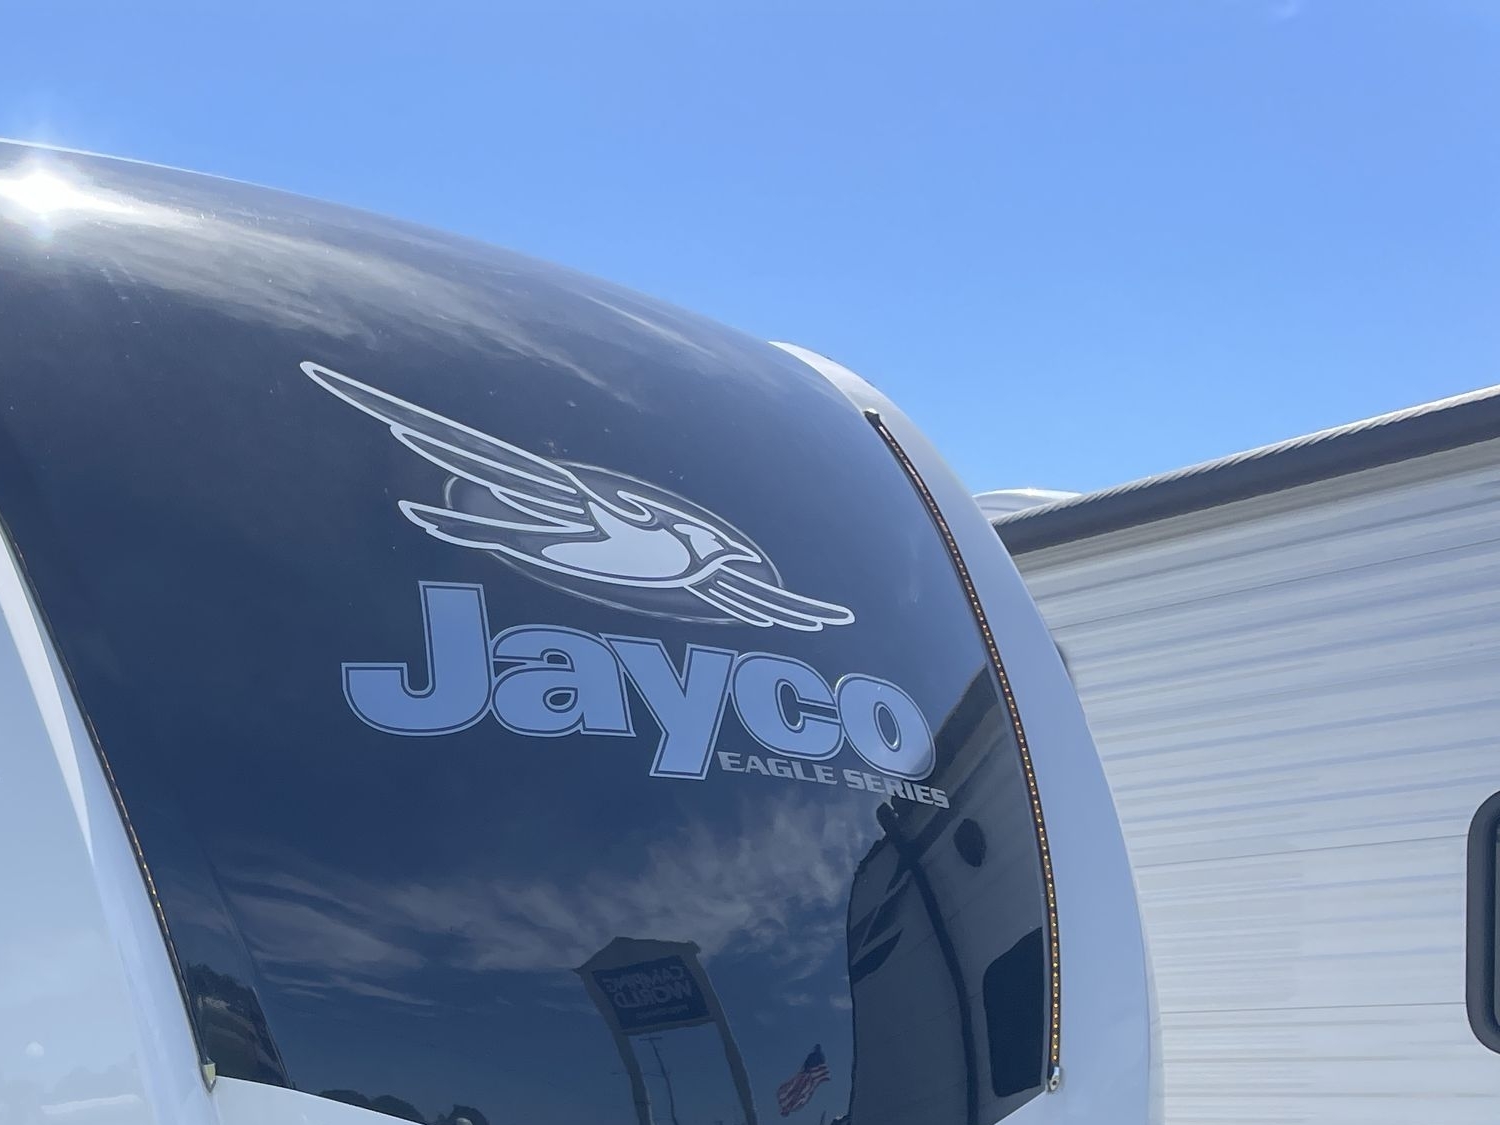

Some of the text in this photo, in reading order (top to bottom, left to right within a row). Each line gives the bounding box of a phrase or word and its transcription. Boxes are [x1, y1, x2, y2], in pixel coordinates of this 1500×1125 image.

[341, 580, 936, 780] Jayco
[717, 751, 950, 809] EAGLE SERIES
